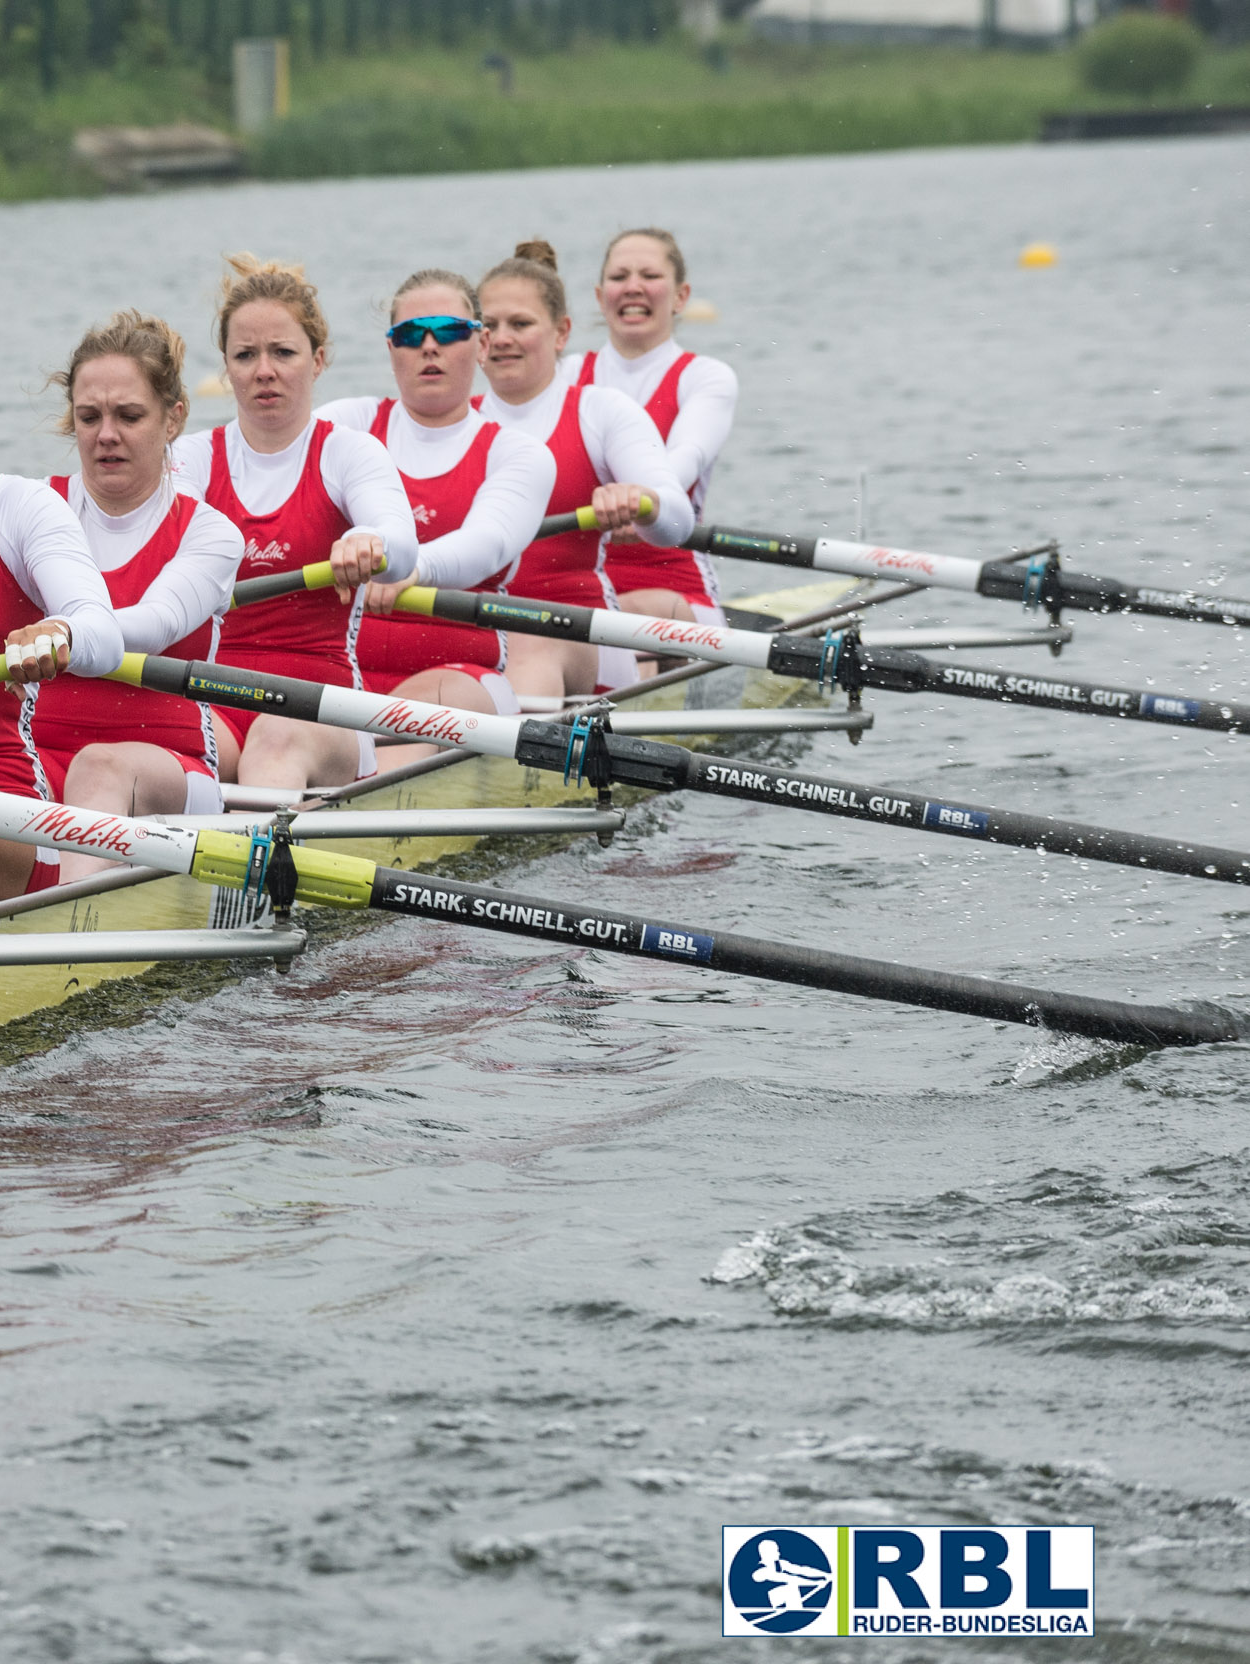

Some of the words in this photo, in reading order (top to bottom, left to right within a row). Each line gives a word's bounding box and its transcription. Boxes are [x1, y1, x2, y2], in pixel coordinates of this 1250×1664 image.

[631, 619, 725, 650] Melitta
[942, 668, 1002, 690] STARK.
[1005, 676, 1087, 703] SCHNELL.
[1091, 689, 1130, 709] GUT.
[1153, 698, 1187, 715] RBL
[365, 699, 468, 745] Melitta
[705, 765, 771, 791] STARK.
[775, 777, 865, 809] SCHNELL.
[869, 796, 913, 818] GUT.
[18, 804, 136, 857] Melitta
[939, 808, 976, 827] RBL
[393, 884, 468, 914] STARK.
[472, 898, 574, 933] SCHNELL.
[578, 918, 629, 943] GUT.
[658, 931, 698, 952] RBL
